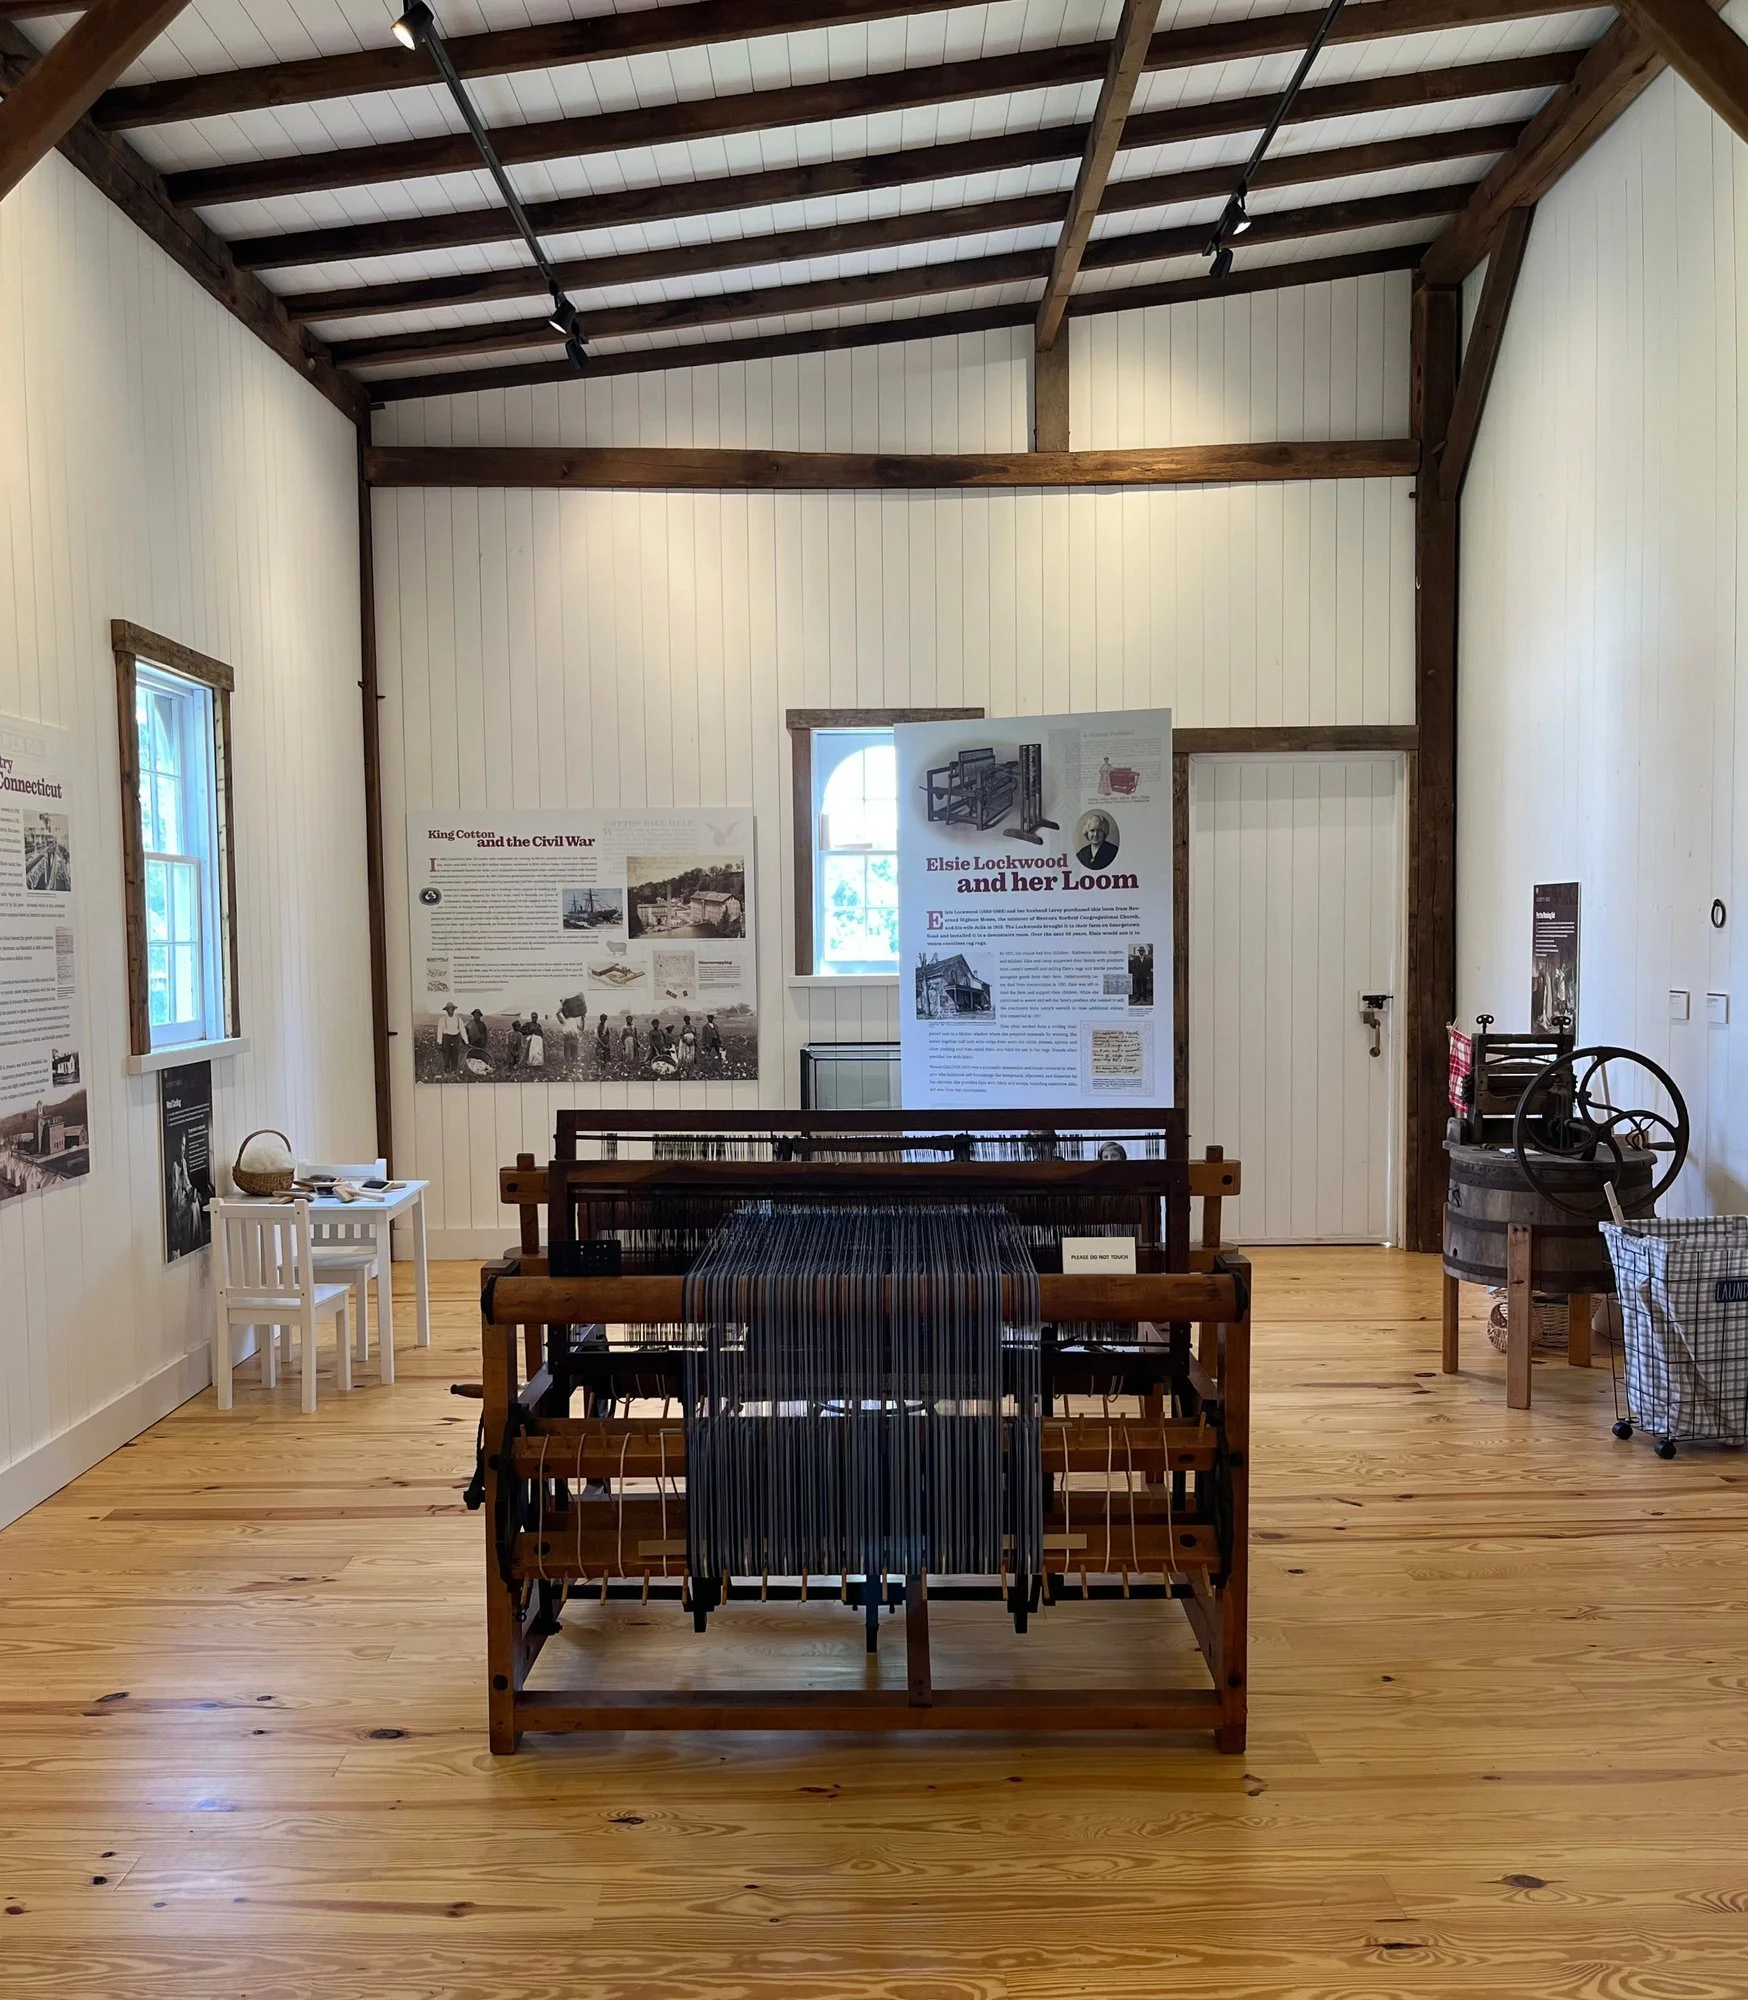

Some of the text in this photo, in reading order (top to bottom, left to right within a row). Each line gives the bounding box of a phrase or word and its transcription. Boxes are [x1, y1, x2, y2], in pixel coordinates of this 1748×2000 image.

[428, 830, 496, 842] King Cotton
[477, 835, 595, 848] and the Civil War
[926, 853, 1069, 872] Elsie Lockwood
[957, 870, 1139, 893] and her Loom
